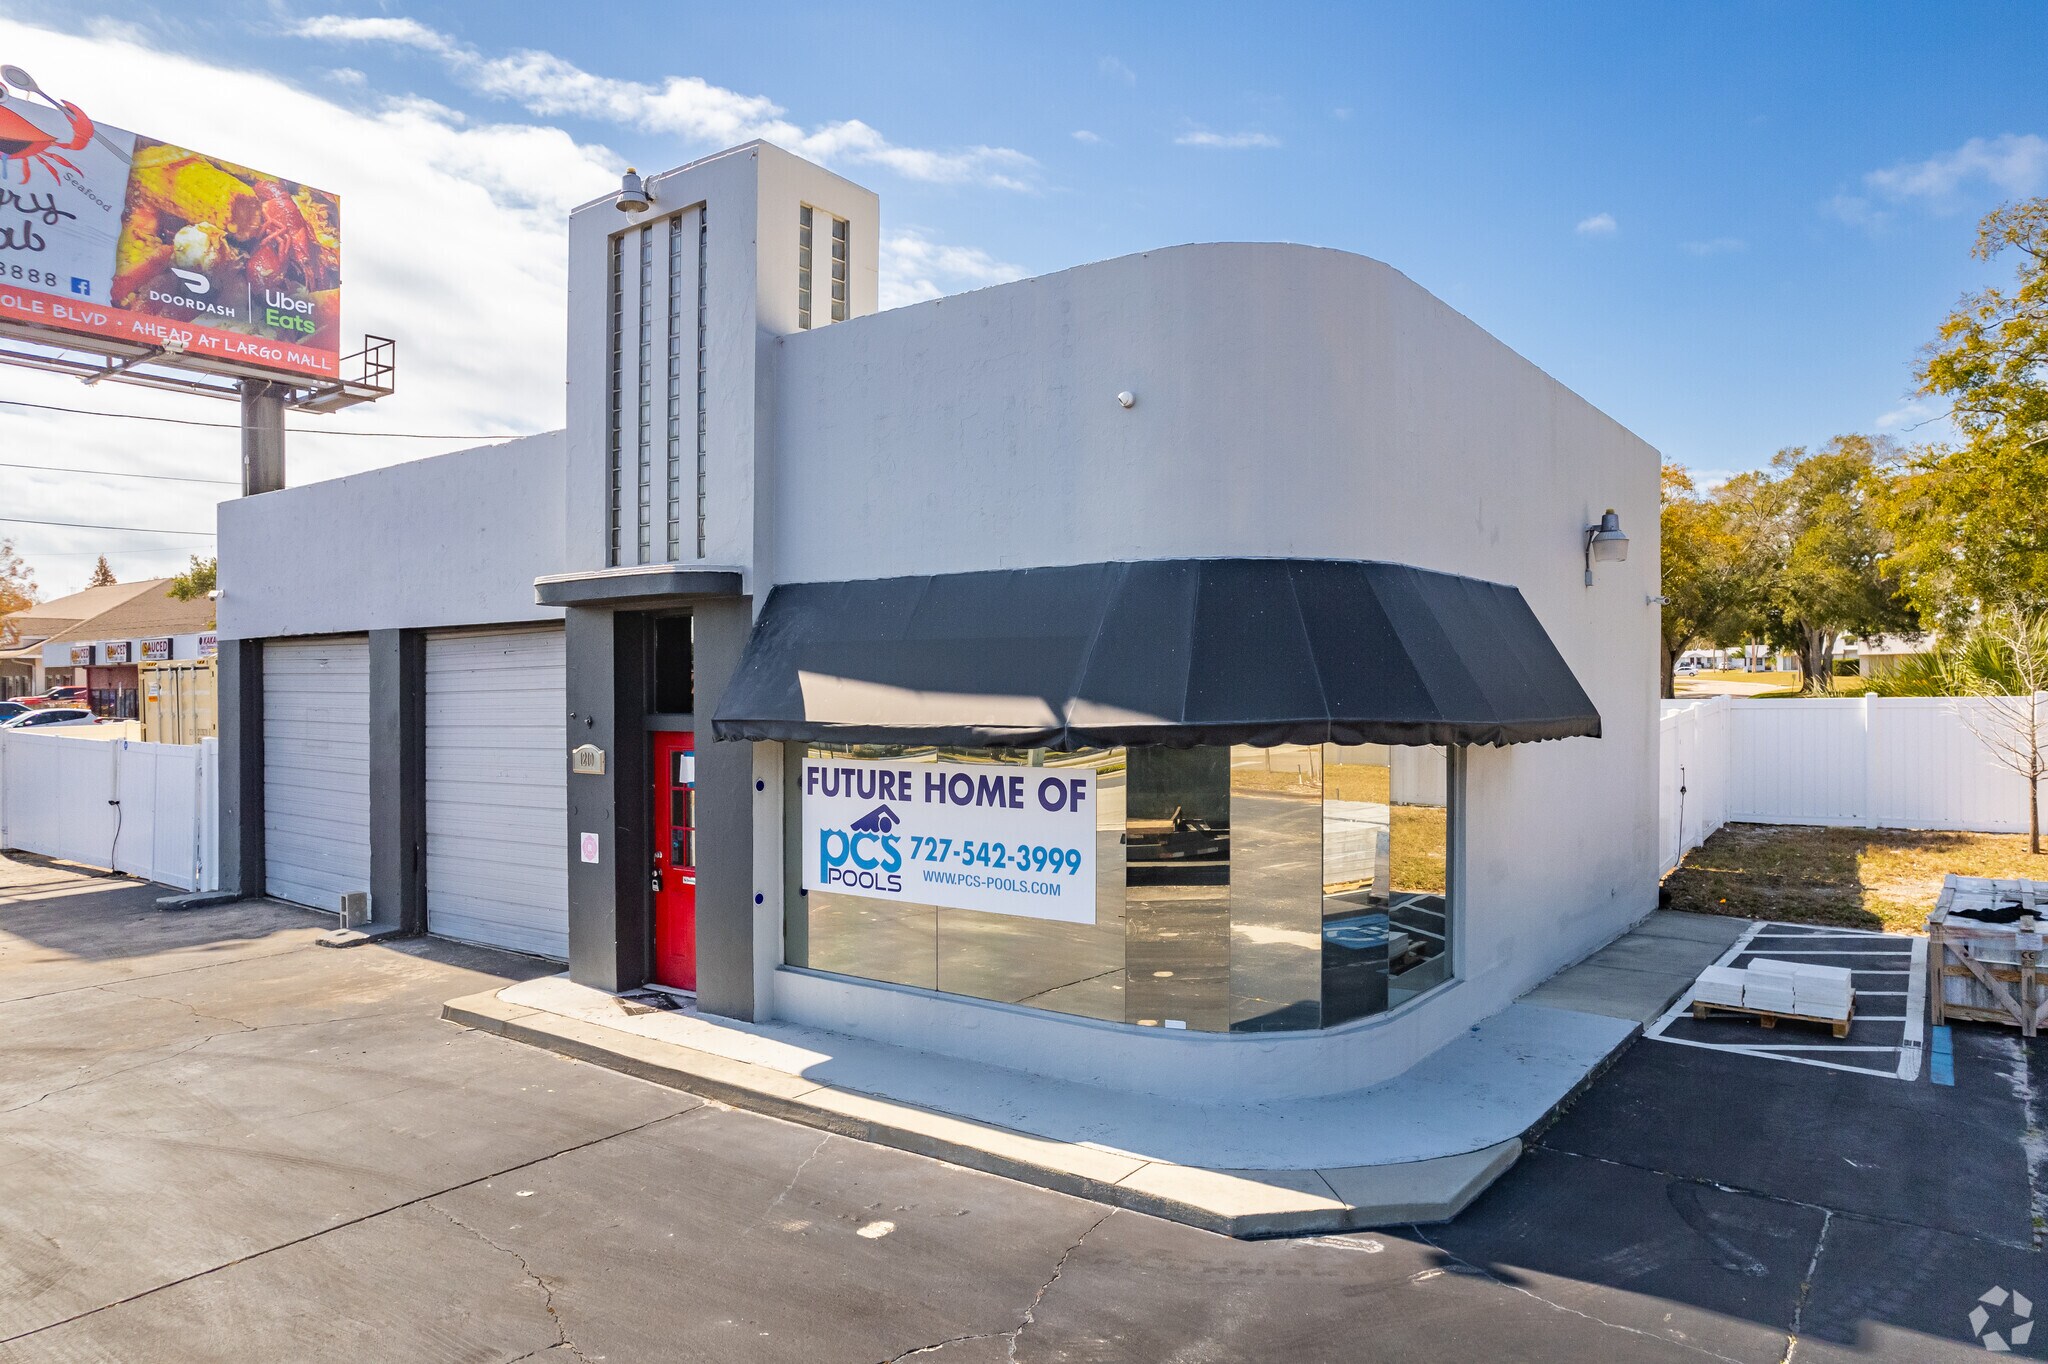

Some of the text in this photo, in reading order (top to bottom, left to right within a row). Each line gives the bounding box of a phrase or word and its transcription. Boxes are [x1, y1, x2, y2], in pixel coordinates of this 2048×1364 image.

[63, 172, 112, 212] Seafood
[150, 290, 235, 317] DOORDASH
[266, 289, 314, 315] Uber
[1, 294, 332, 371] OLE BLVD AHEAD AT LARGO MALL
[266, 308, 315, 334] Eats
[143, 641, 168, 656] SAUCED
[807, 766, 1087, 812] FUTURE HOME OF
[910, 836, 1082, 876] 727-542-3999
[828, 868, 902, 892] POOLS
[922, 870, 1061, 897] WWW.PCS-POOLS.COM
